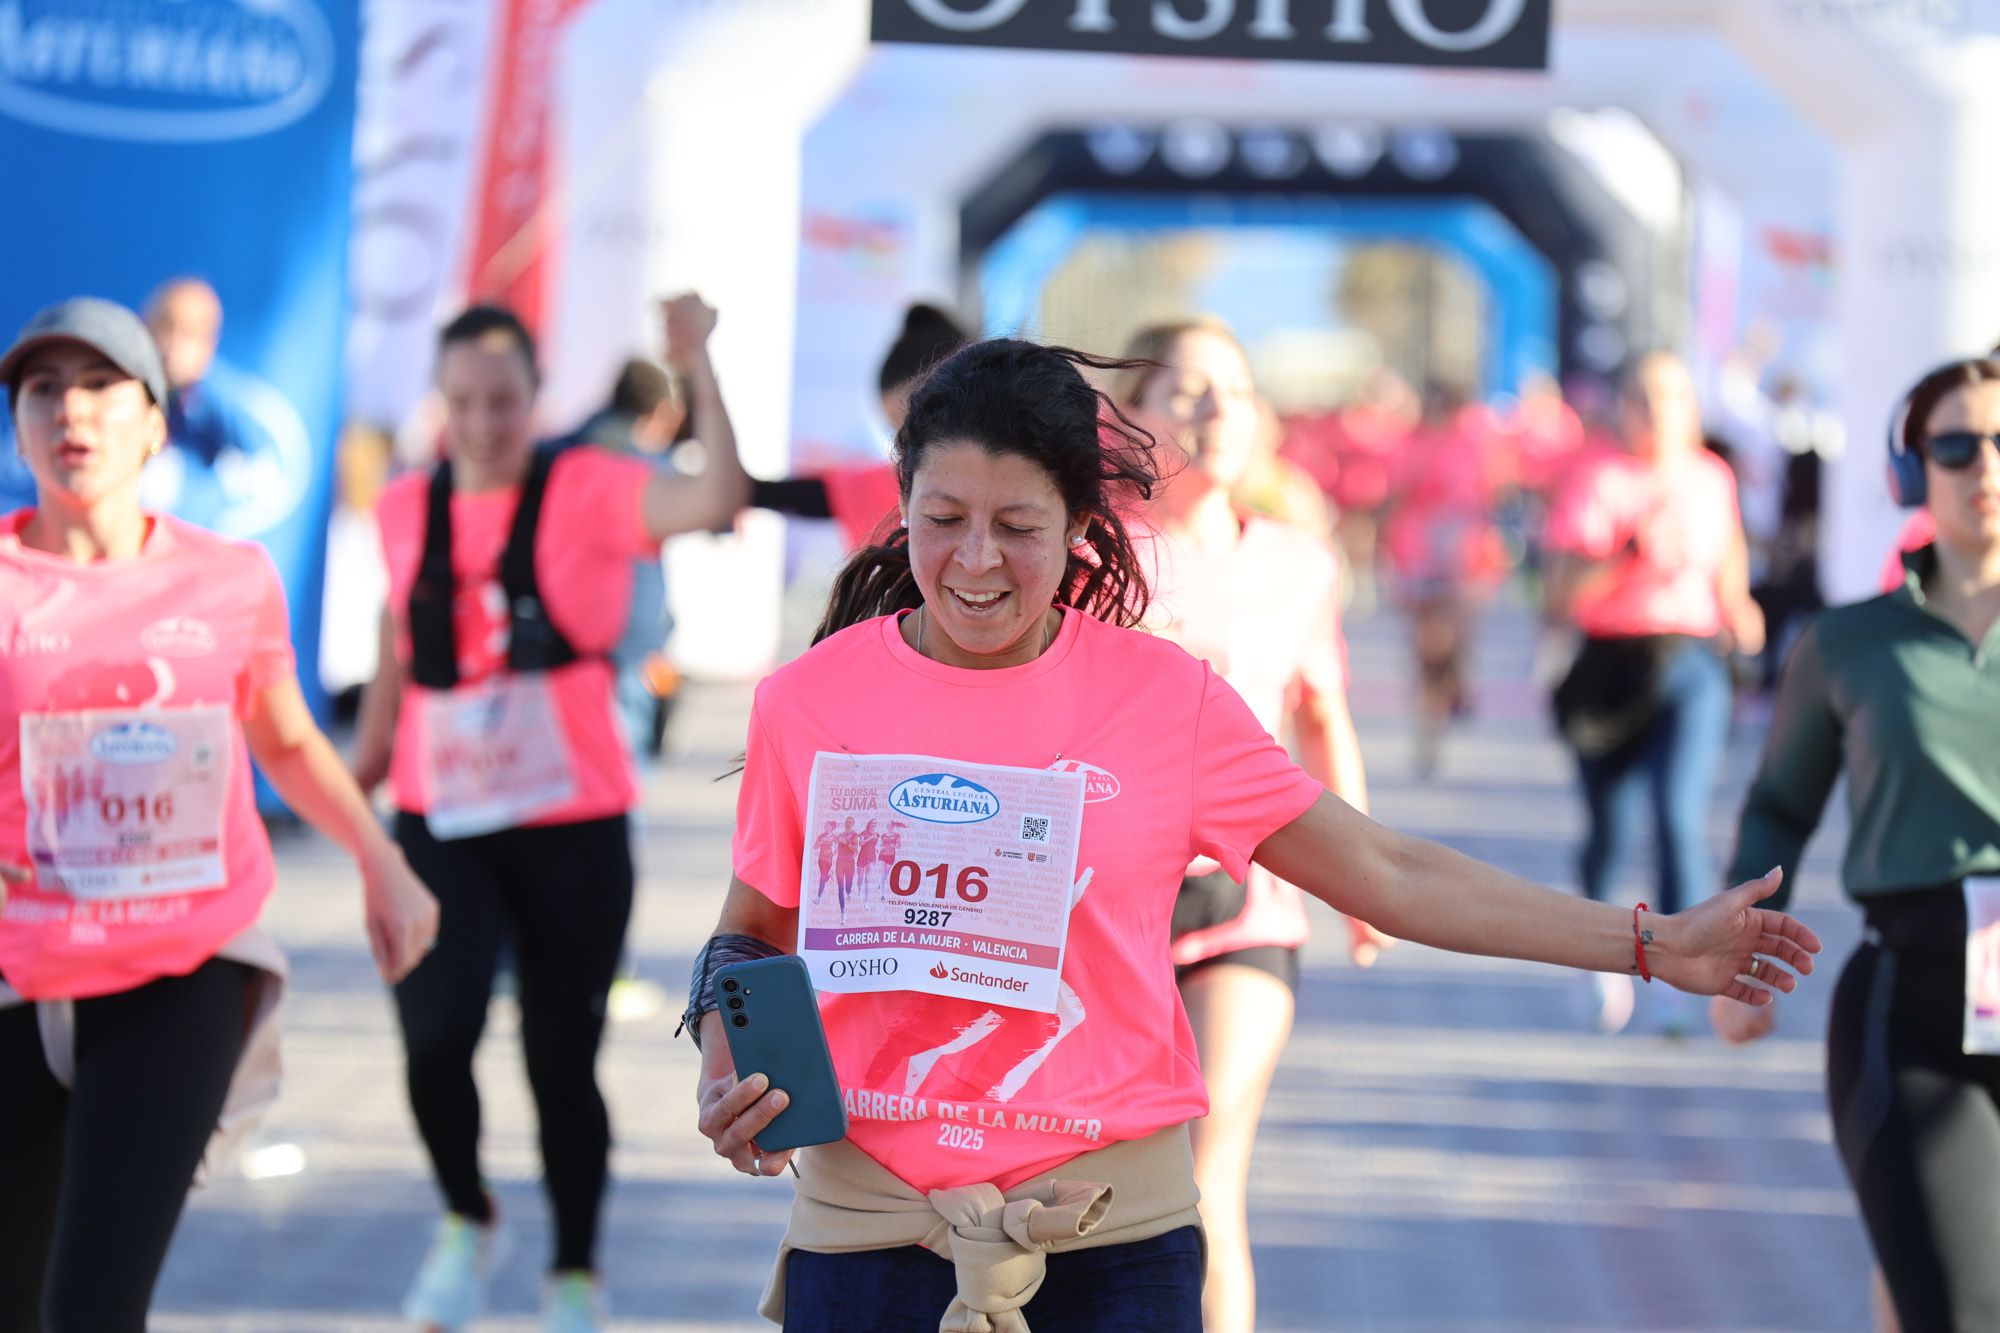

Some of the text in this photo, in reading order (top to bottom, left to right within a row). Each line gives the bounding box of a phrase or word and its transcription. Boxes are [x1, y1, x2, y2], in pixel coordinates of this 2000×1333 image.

[829, 788, 878, 796] TU DORSAL
[831, 797, 878, 811] SUMA
[896, 788, 991, 815] ASTURIANA
[914, 787, 949, 796] CENTRAL
[952, 790, 989, 800] LECHERA
[104, 793, 174, 826] 016
[889, 860, 990, 903] 016
[904, 908, 952, 927] 9287
[918, 902, 949, 910] VIOLENCIA
[835, 931, 1028, 960] CARRERA DE LA MUJER VALENCIA
[829, 957, 1029, 992] OYSHO Santander
[841, 1088, 1102, 1142] ARRERA DE LA MUJER
[937, 1123, 984, 1150] 2025
